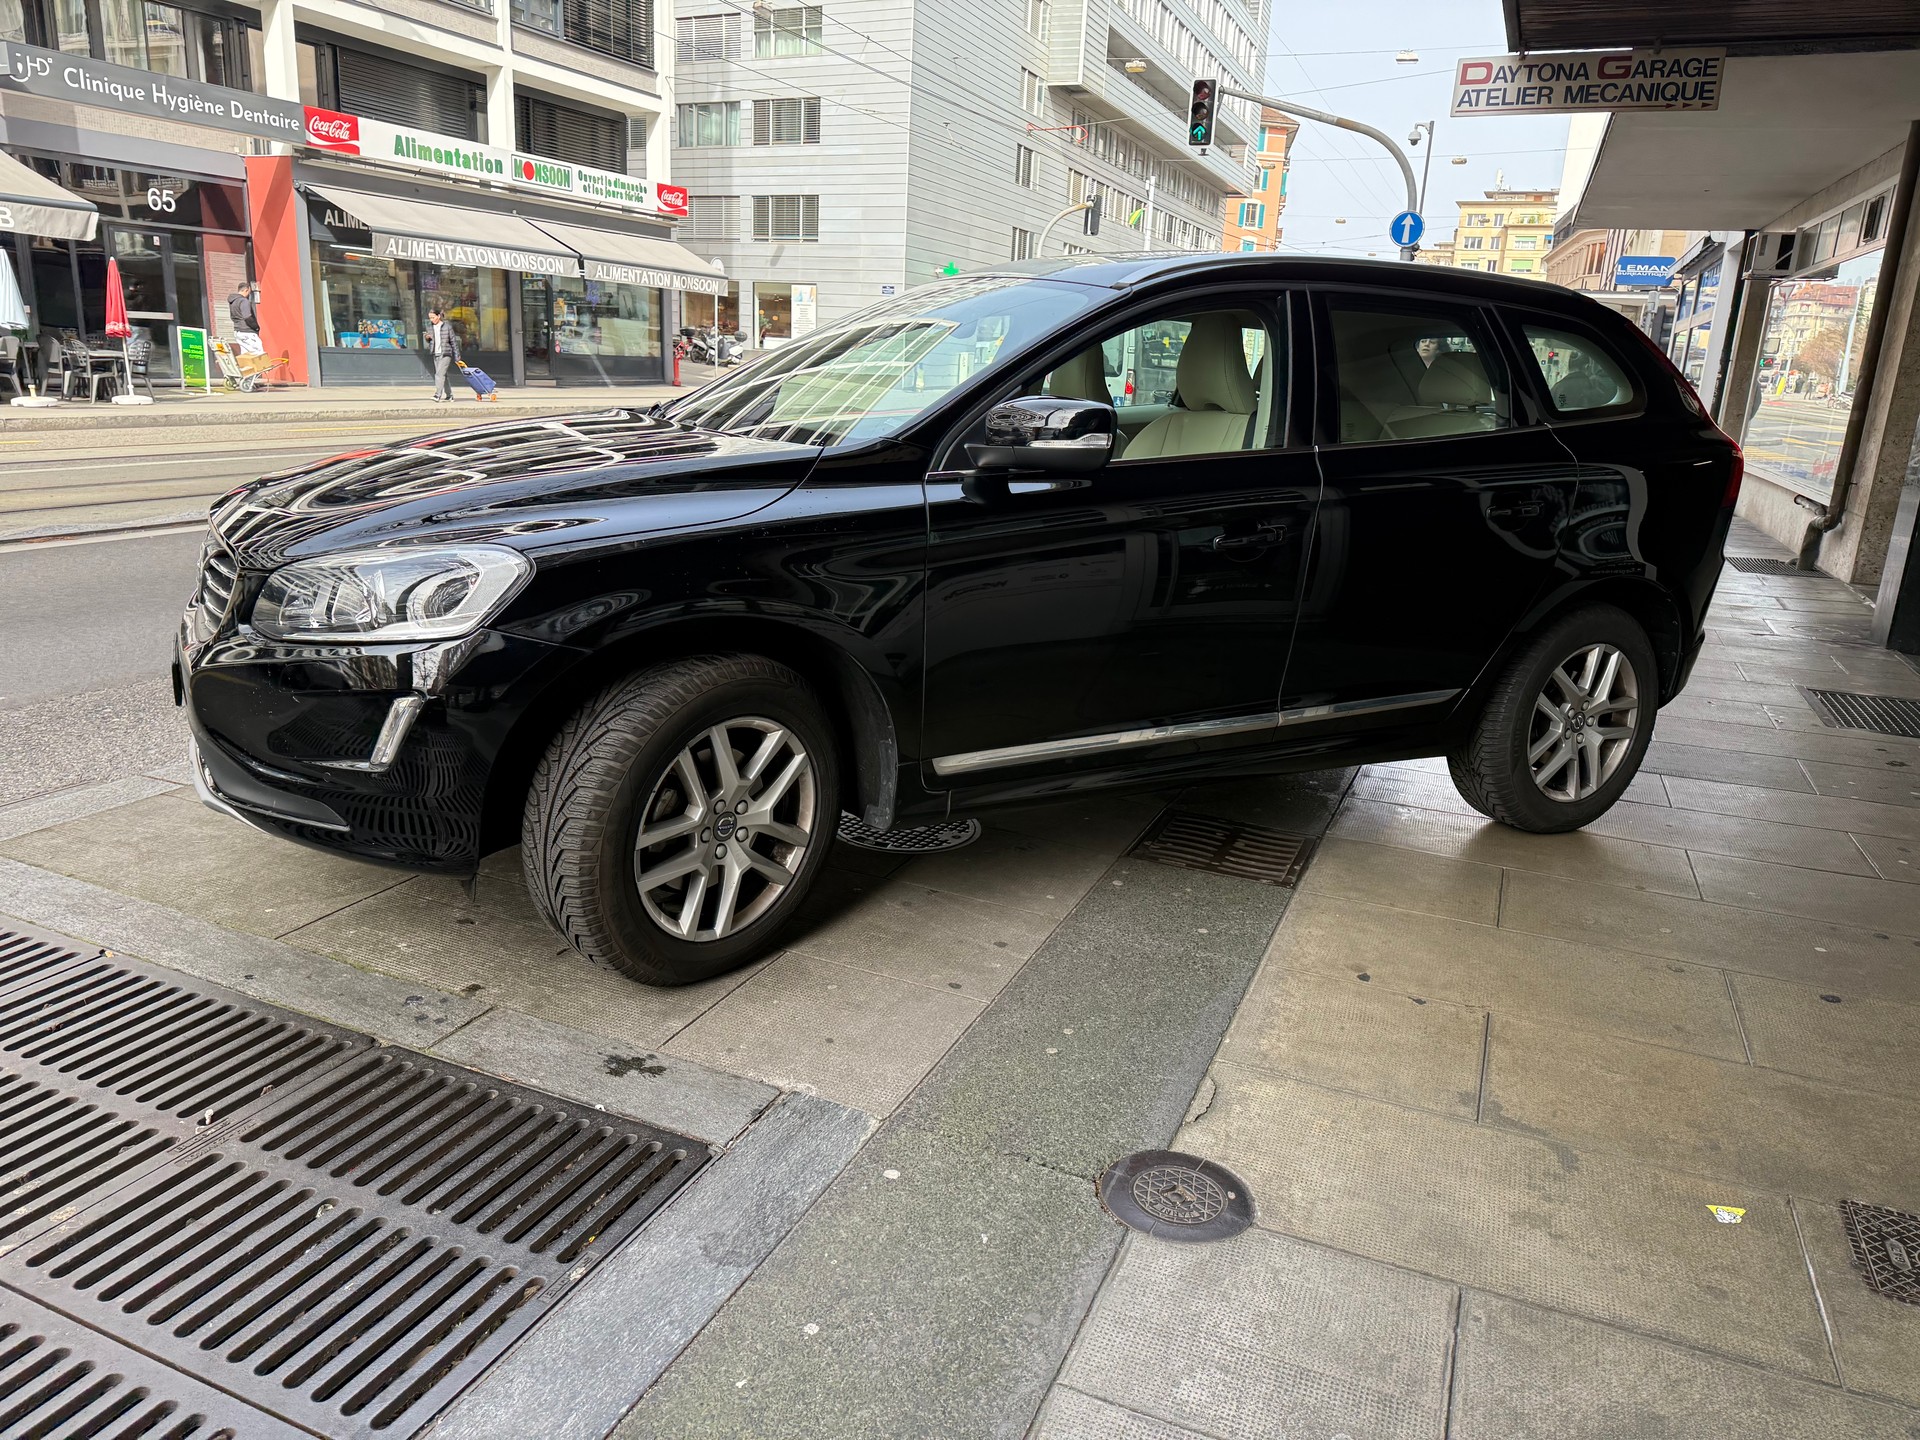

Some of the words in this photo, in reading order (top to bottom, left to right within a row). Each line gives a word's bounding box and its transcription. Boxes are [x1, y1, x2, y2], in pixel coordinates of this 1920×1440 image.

[1460, 61, 1589, 85] DAYTONA
[1597, 55, 1720, 80] GARAGE
[64, 67, 145, 101] Clinique
[152, 83, 225, 113] Hygiène
[230, 100, 300, 130] Dentaire
[1456, 85, 1554, 108] ATELIER
[1563, 80, 1717, 104] MECANIQUE
[309, 115, 352, 140] Coca-Cola
[394, 134, 503, 174] Alimentation
[514, 158, 570, 188] MONSOON
[147, 187, 176, 213] 65
[661, 190, 684, 206] Coca-Cola
[385, 238, 498, 266] ALIMENTATION
[500, 250, 564, 273] MONSOON
[595, 265, 671, 286] ALIMENTATION
[673, 275, 719, 293] MONSOON
